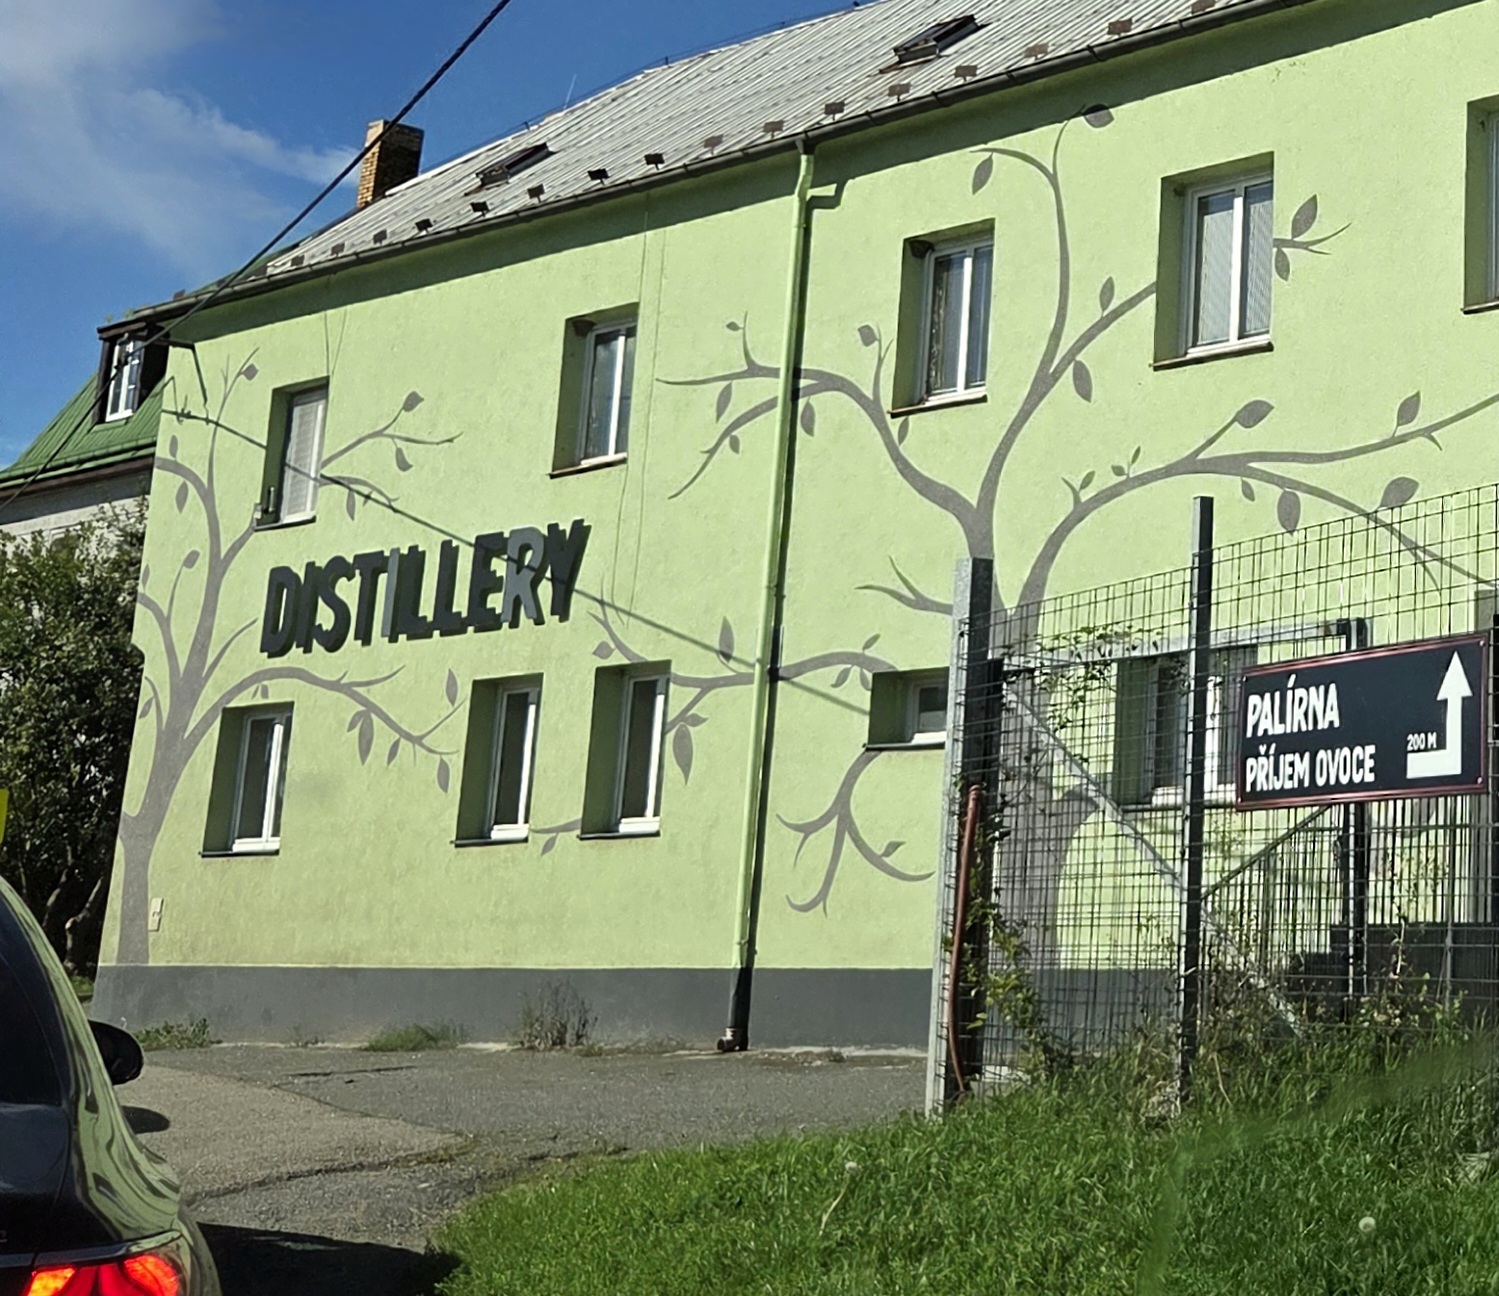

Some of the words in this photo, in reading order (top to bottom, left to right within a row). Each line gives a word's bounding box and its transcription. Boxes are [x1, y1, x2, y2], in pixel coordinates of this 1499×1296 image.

[260, 518, 592, 659] DISTILLERY
[1246, 674, 1339, 738] PALÍRNA
[1245, 743, 1309, 792] PŘÍJEM
[1315, 744, 1376, 786] OVOCE
[1406, 733, 1426, 751] 200
[1428, 732, 1437, 749] M
